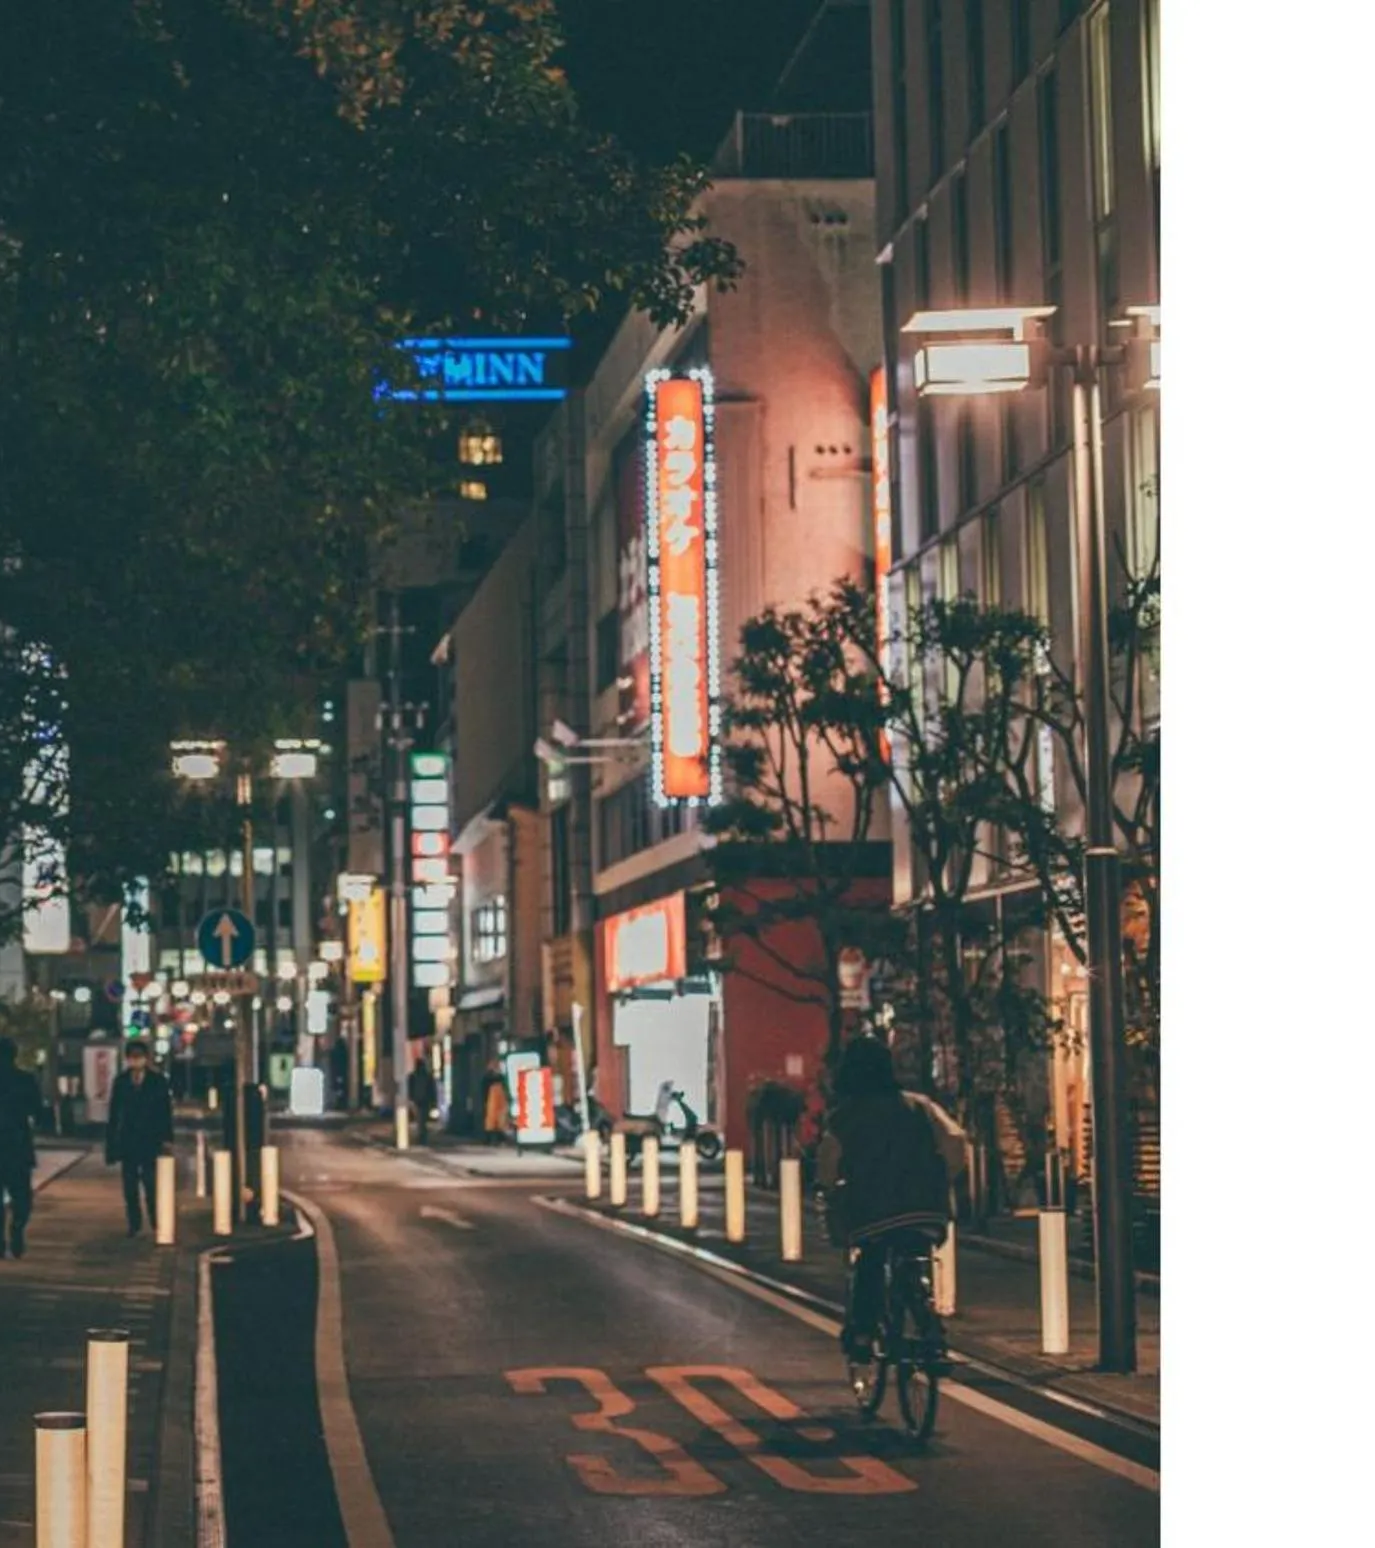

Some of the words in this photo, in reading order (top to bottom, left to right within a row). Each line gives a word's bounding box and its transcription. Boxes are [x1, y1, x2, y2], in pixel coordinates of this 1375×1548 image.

[663, 415, 701, 556] カラオケ
[503, 1365, 919, 1495] 30
